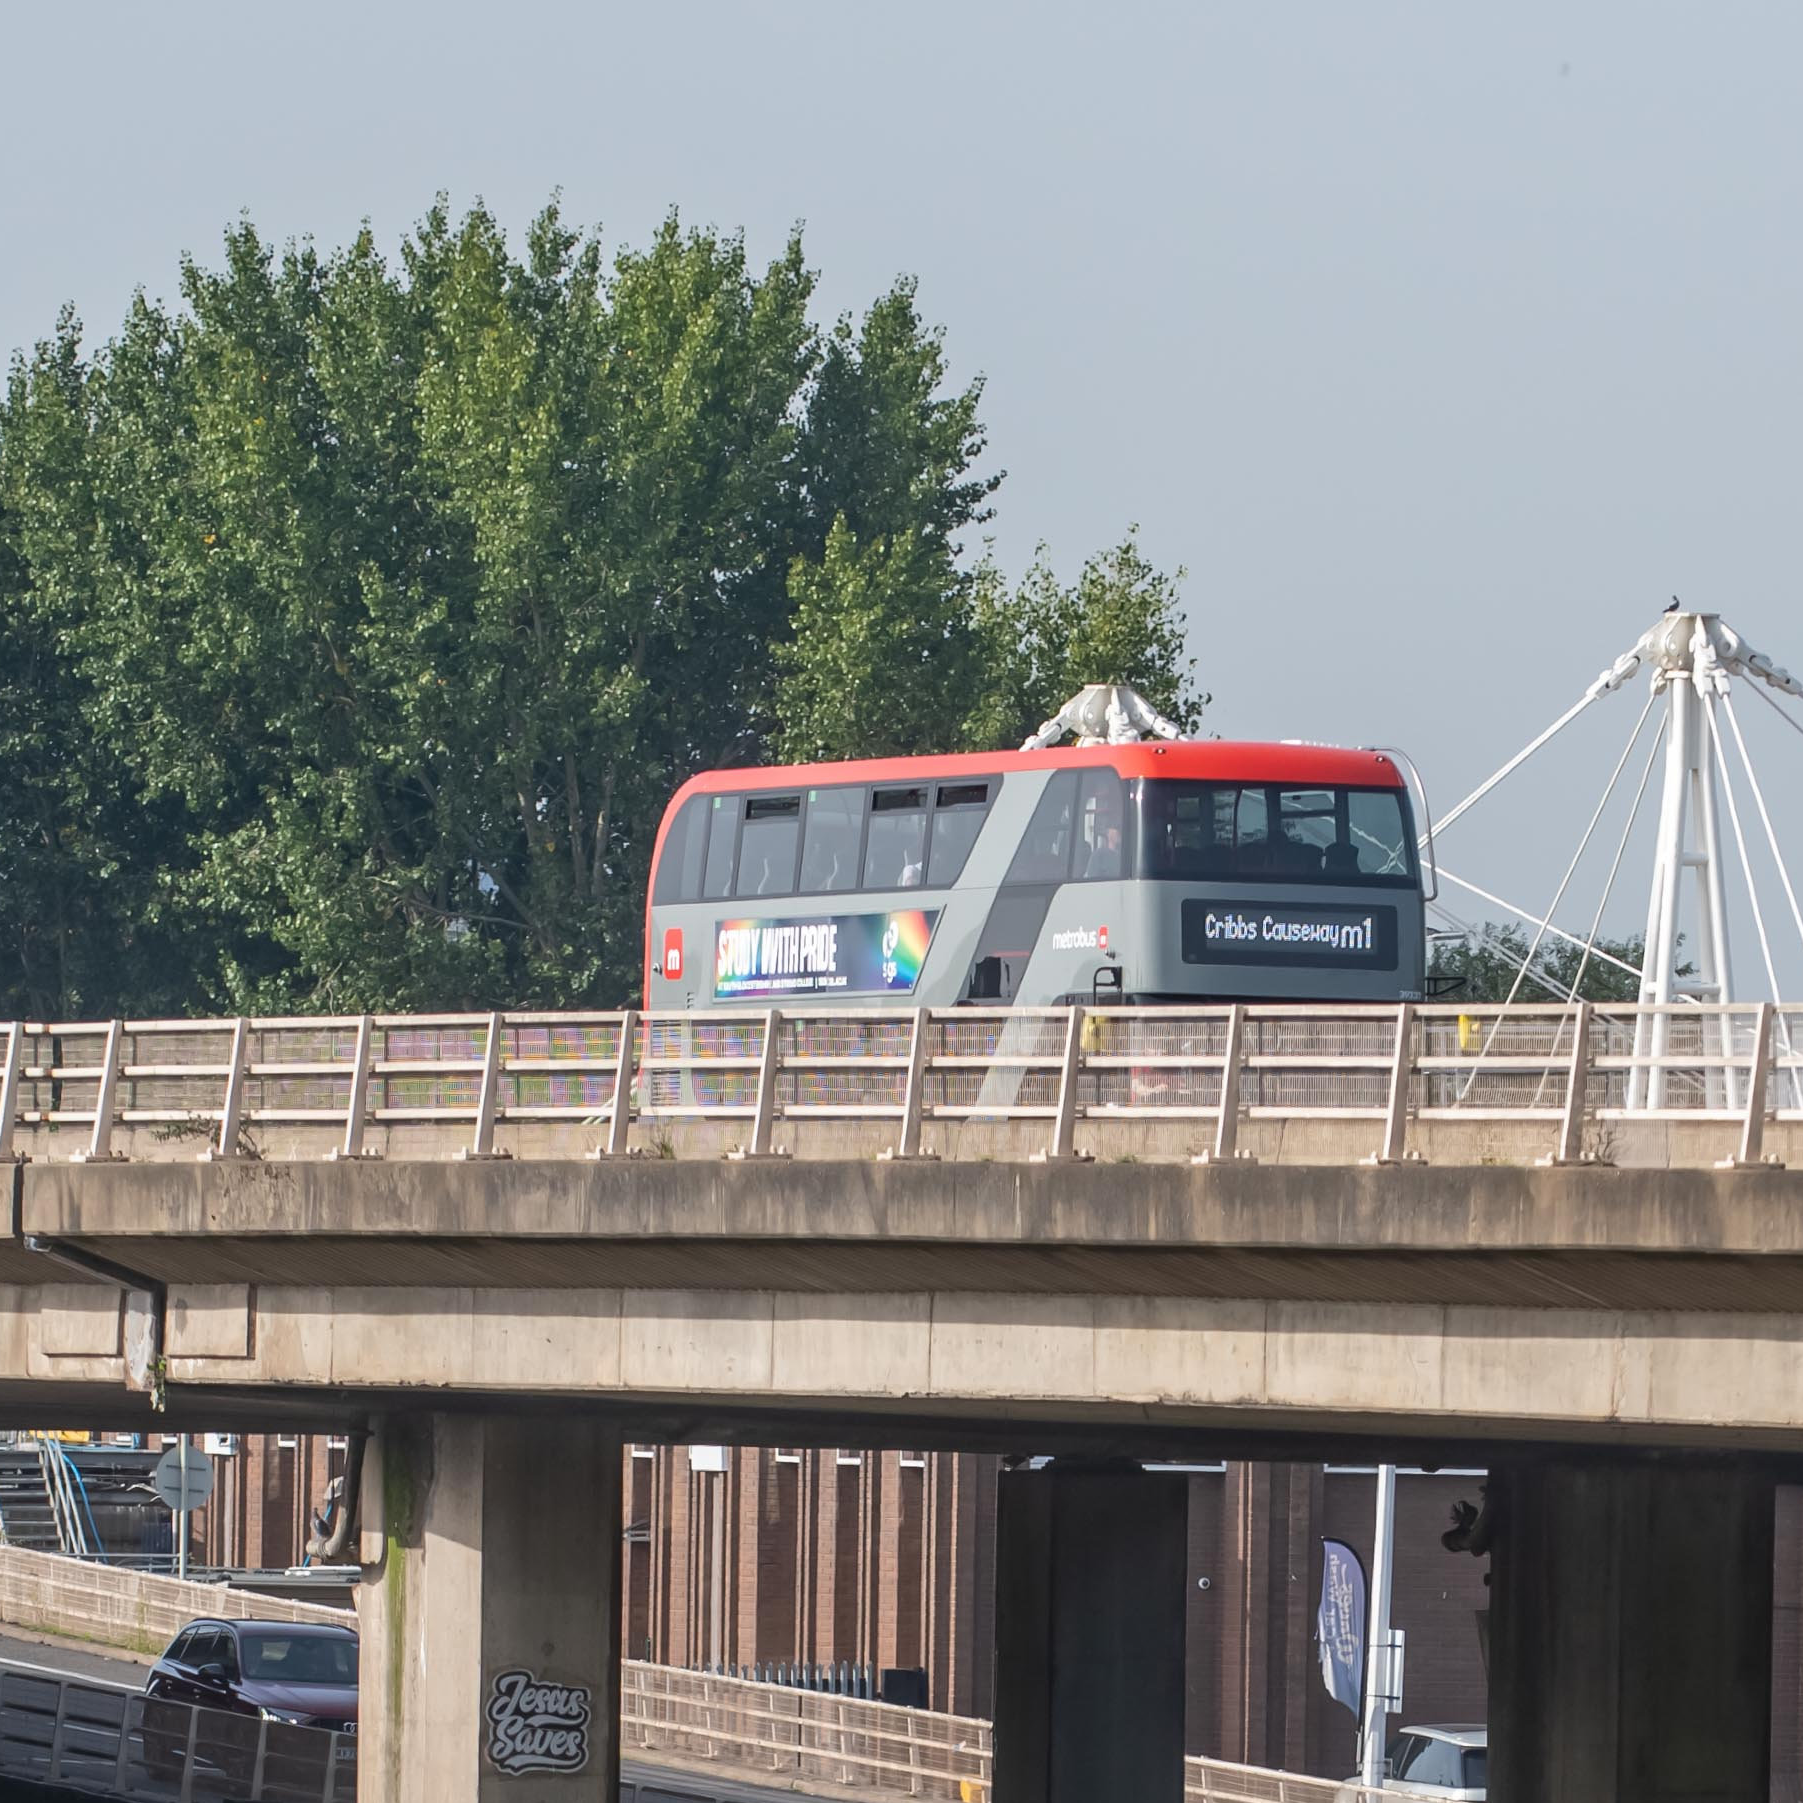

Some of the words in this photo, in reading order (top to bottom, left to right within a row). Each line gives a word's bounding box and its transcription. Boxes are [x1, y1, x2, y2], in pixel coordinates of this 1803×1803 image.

[717, 929, 760, 976] STUDY
[761, 928, 799, 975] WITH
[799, 924, 838, 972] PRIDE
[1053, 926, 1097, 950] metrobus
[1205, 914, 1257, 940] Cribbs
[1263, 916, 1339, 949] Causeway
[1341, 917, 1373, 950] m1
[667, 948, 680, 971] m
[492, 1675, 585, 1723] Jesus
[492, 1715, 582, 1767] Saves
